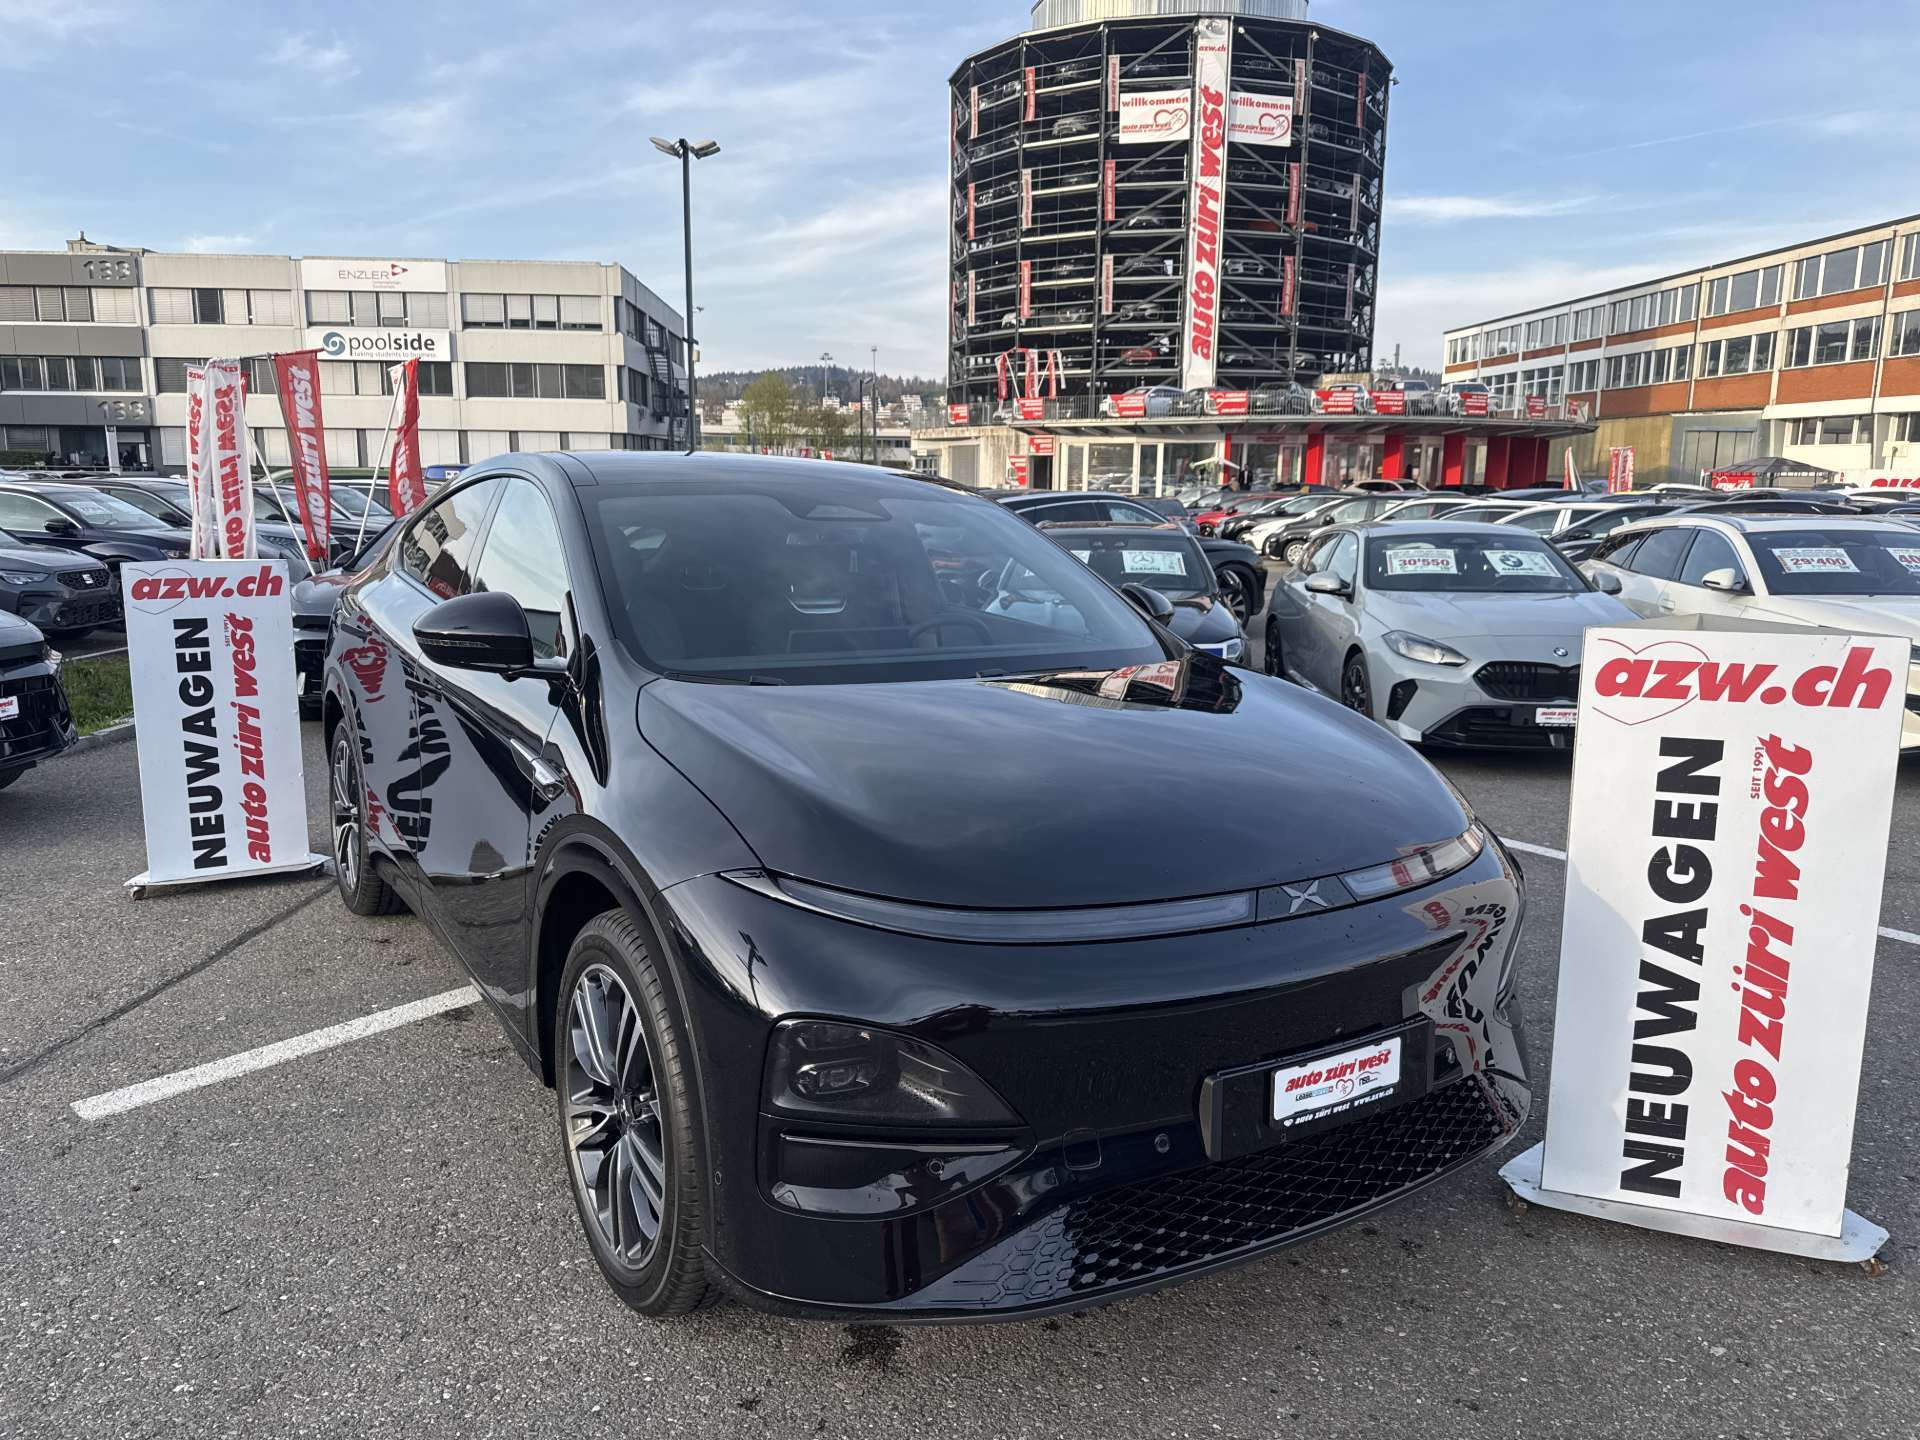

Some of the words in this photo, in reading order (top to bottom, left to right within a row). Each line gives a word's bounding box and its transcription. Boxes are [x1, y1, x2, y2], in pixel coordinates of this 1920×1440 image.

[1122, 96, 1189, 107] willkommen
[1199, 84, 1225, 177] west
[1231, 97, 1291, 110] willkommen
[1191, 181, 1220, 268] züri
[338, 270, 390, 280] ENZLER
[349, 332, 436, 356] poolside
[1190, 270, 1217, 361] auto
[374, 350, 401, 358] students
[287, 364, 315, 429] west
[297, 431, 322, 493] züri
[131, 565, 283, 600] azw.ch
[1397, 558, 1450, 566] 30'550
[1790, 557, 1847, 566] 29'400
[225, 612, 259, 697] west
[1594, 646, 1893, 709] azw.ch
[173, 617, 228, 870] NEUWAGEN
[230, 701, 265, 780] züri
[1753, 746, 1764, 773] 1991
[1750, 776, 1761, 799] SEIT
[1753, 733, 1813, 900] west
[239, 782, 272, 864] auto
[1619, 736, 1725, 1199] NEUWAGEN
[1730, 903, 1794, 1063] züri
[1284, 1070, 1323, 1092] auto
[1323, 1058, 1357, 1083] züri
[1358, 1048, 1391, 1072] west
[1720, 1058, 1777, 1215] auto
